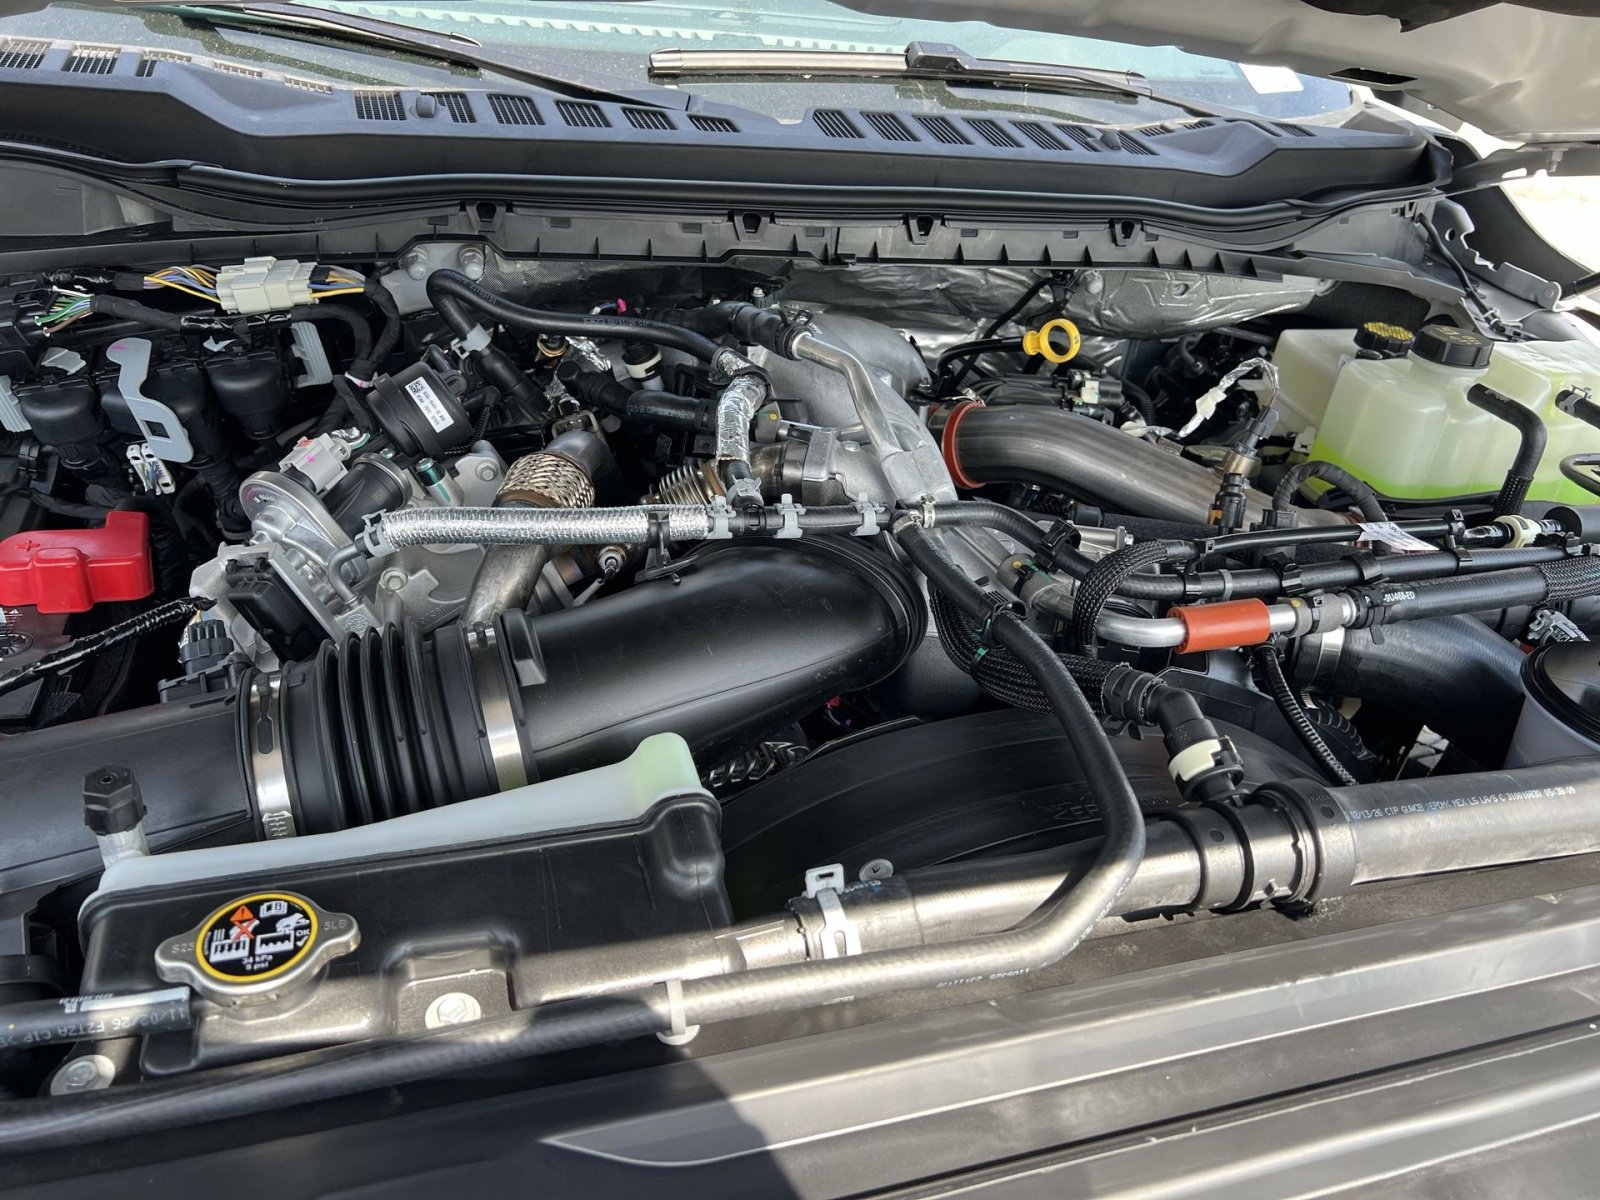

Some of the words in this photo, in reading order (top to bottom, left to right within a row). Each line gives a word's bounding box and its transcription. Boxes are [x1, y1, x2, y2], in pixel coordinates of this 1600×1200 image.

[296, 929, 311, 938] OK
[242, 956, 254, 966] 34
[255, 953, 274, 964] kPa
[253, 961, 270, 972] psi
